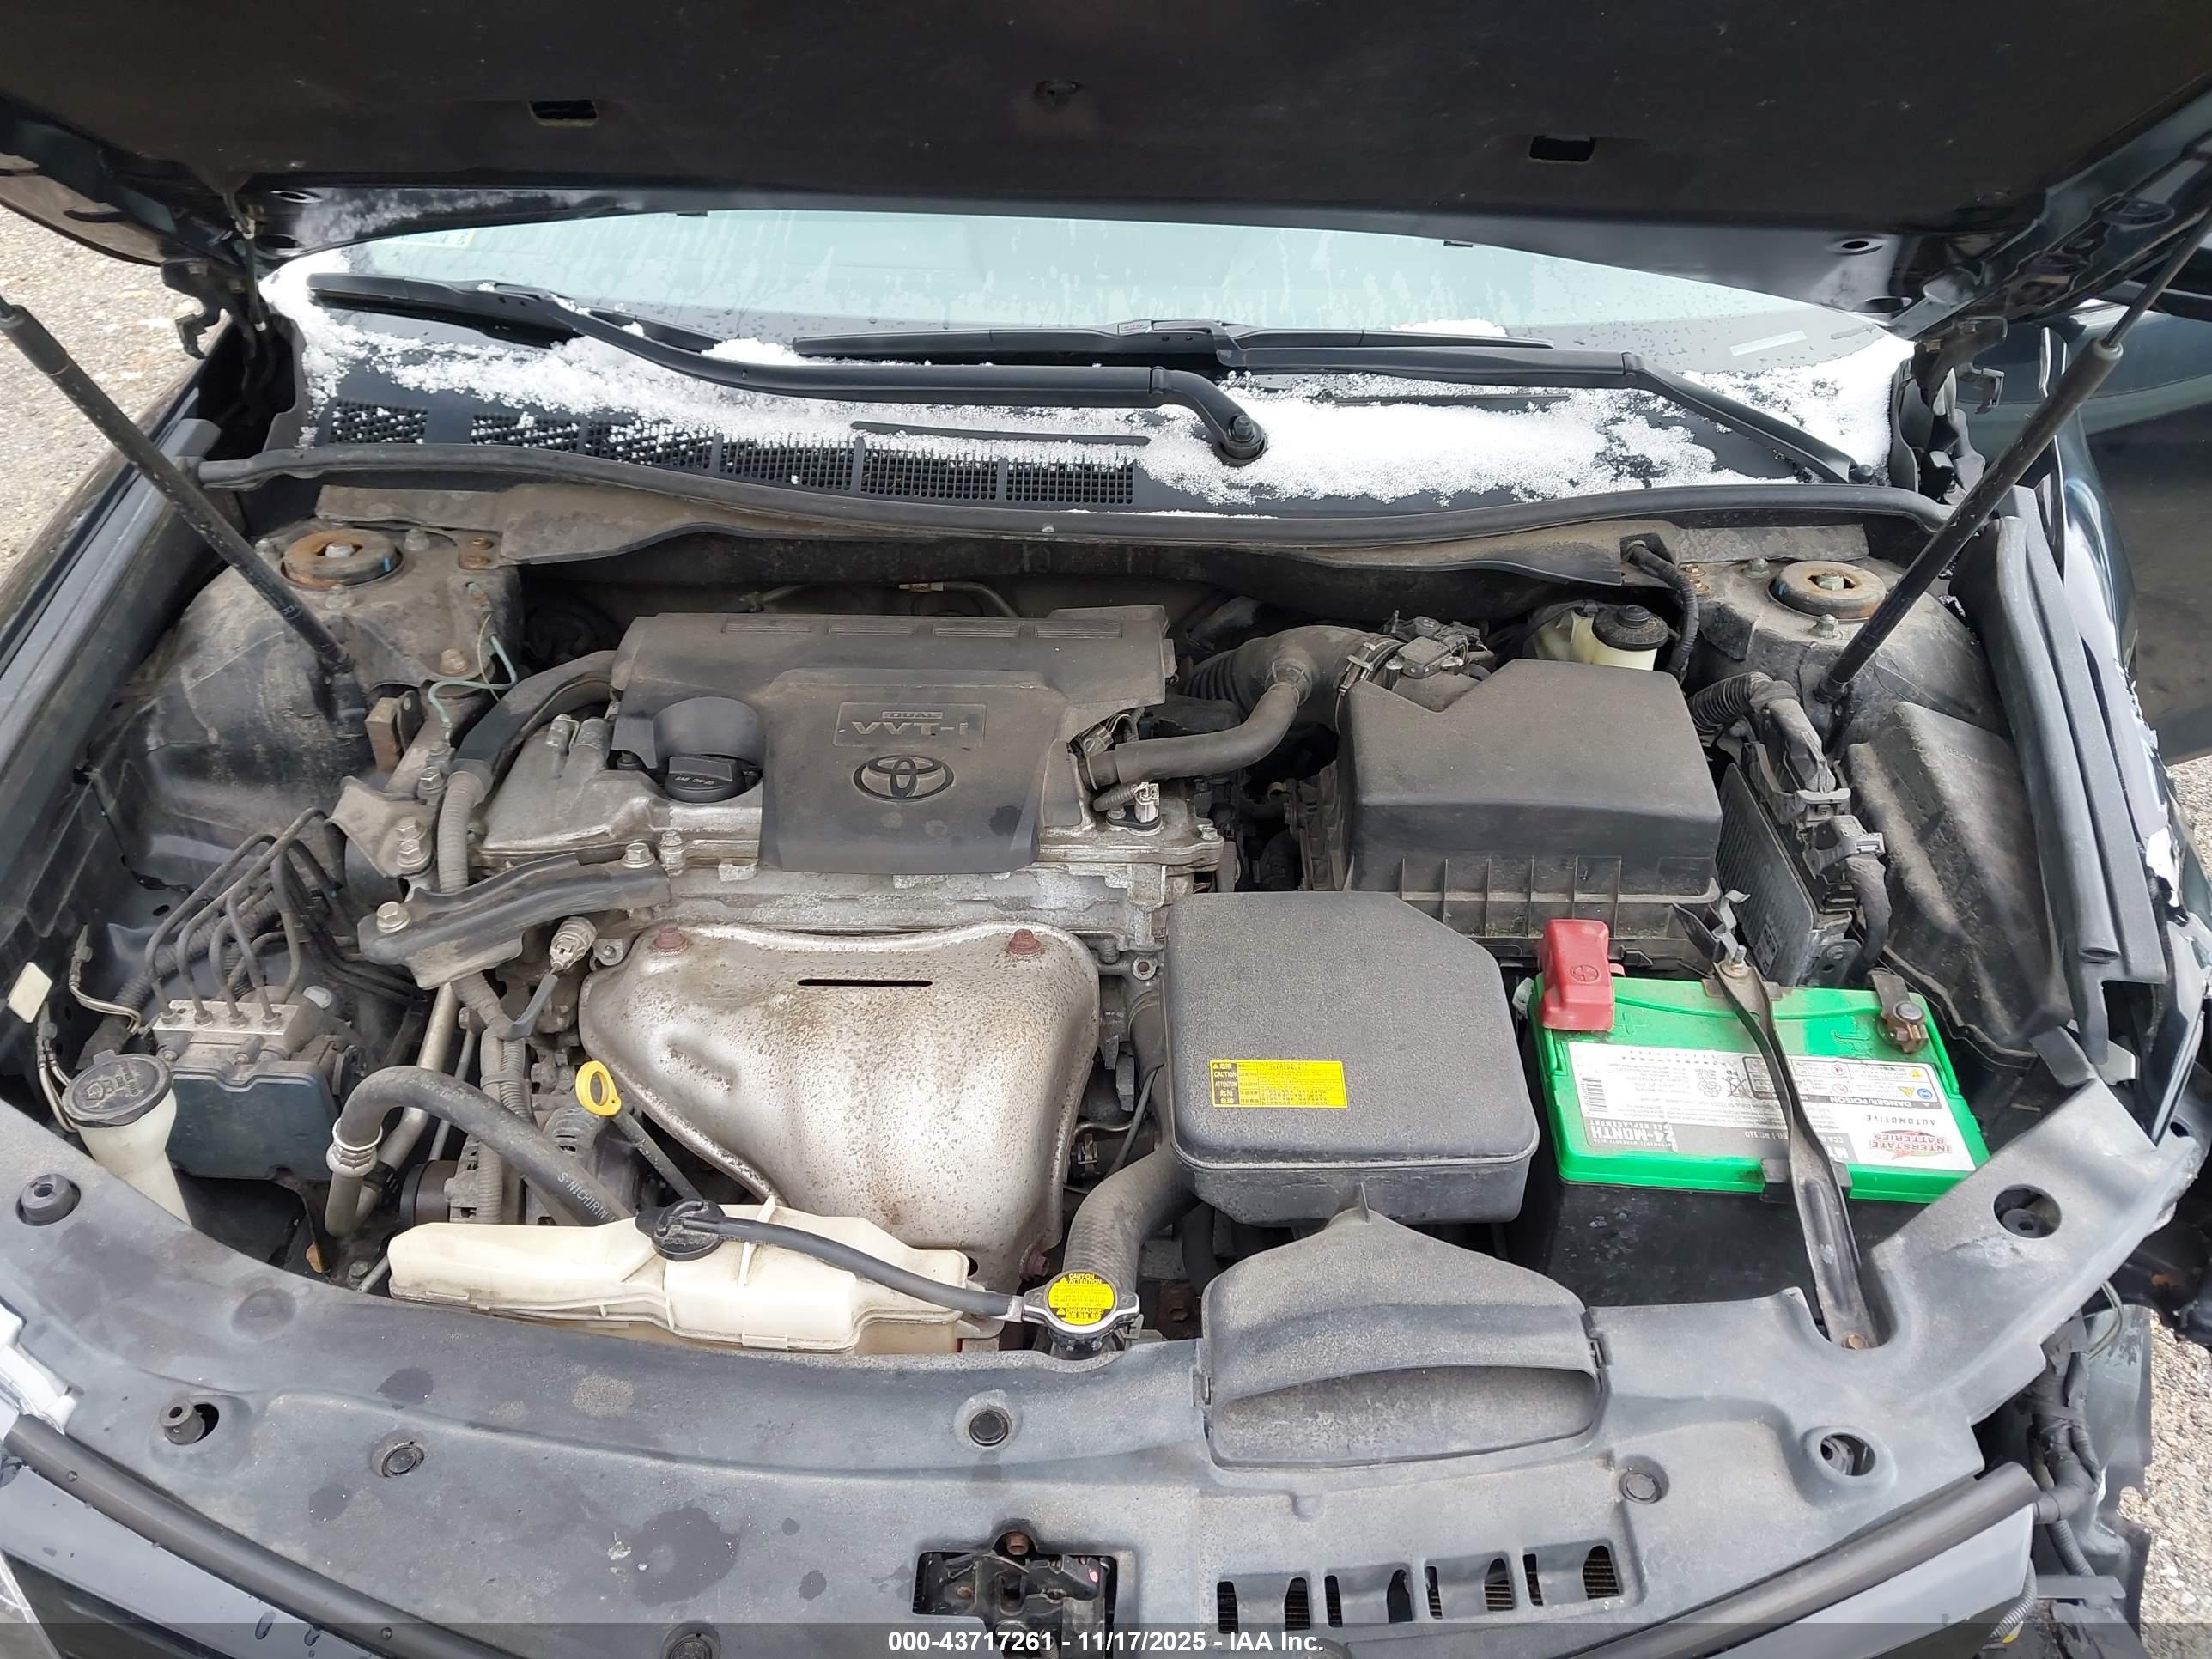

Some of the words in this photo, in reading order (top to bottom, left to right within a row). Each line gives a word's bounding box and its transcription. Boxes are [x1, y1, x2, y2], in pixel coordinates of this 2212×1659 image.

[1829, 1096, 1912, 1108] DANGER/POISON
[1590, 1119, 1650, 1129] REPLACEMENT
[1866, 1115, 1936, 1126] AUTOMOTIVE
[1591, 1125, 1677, 1143] 24-MONTH
[1875, 1133, 1944, 1145] BATTERIES
[1872, 1140, 1950, 1153] INTERSTATE
